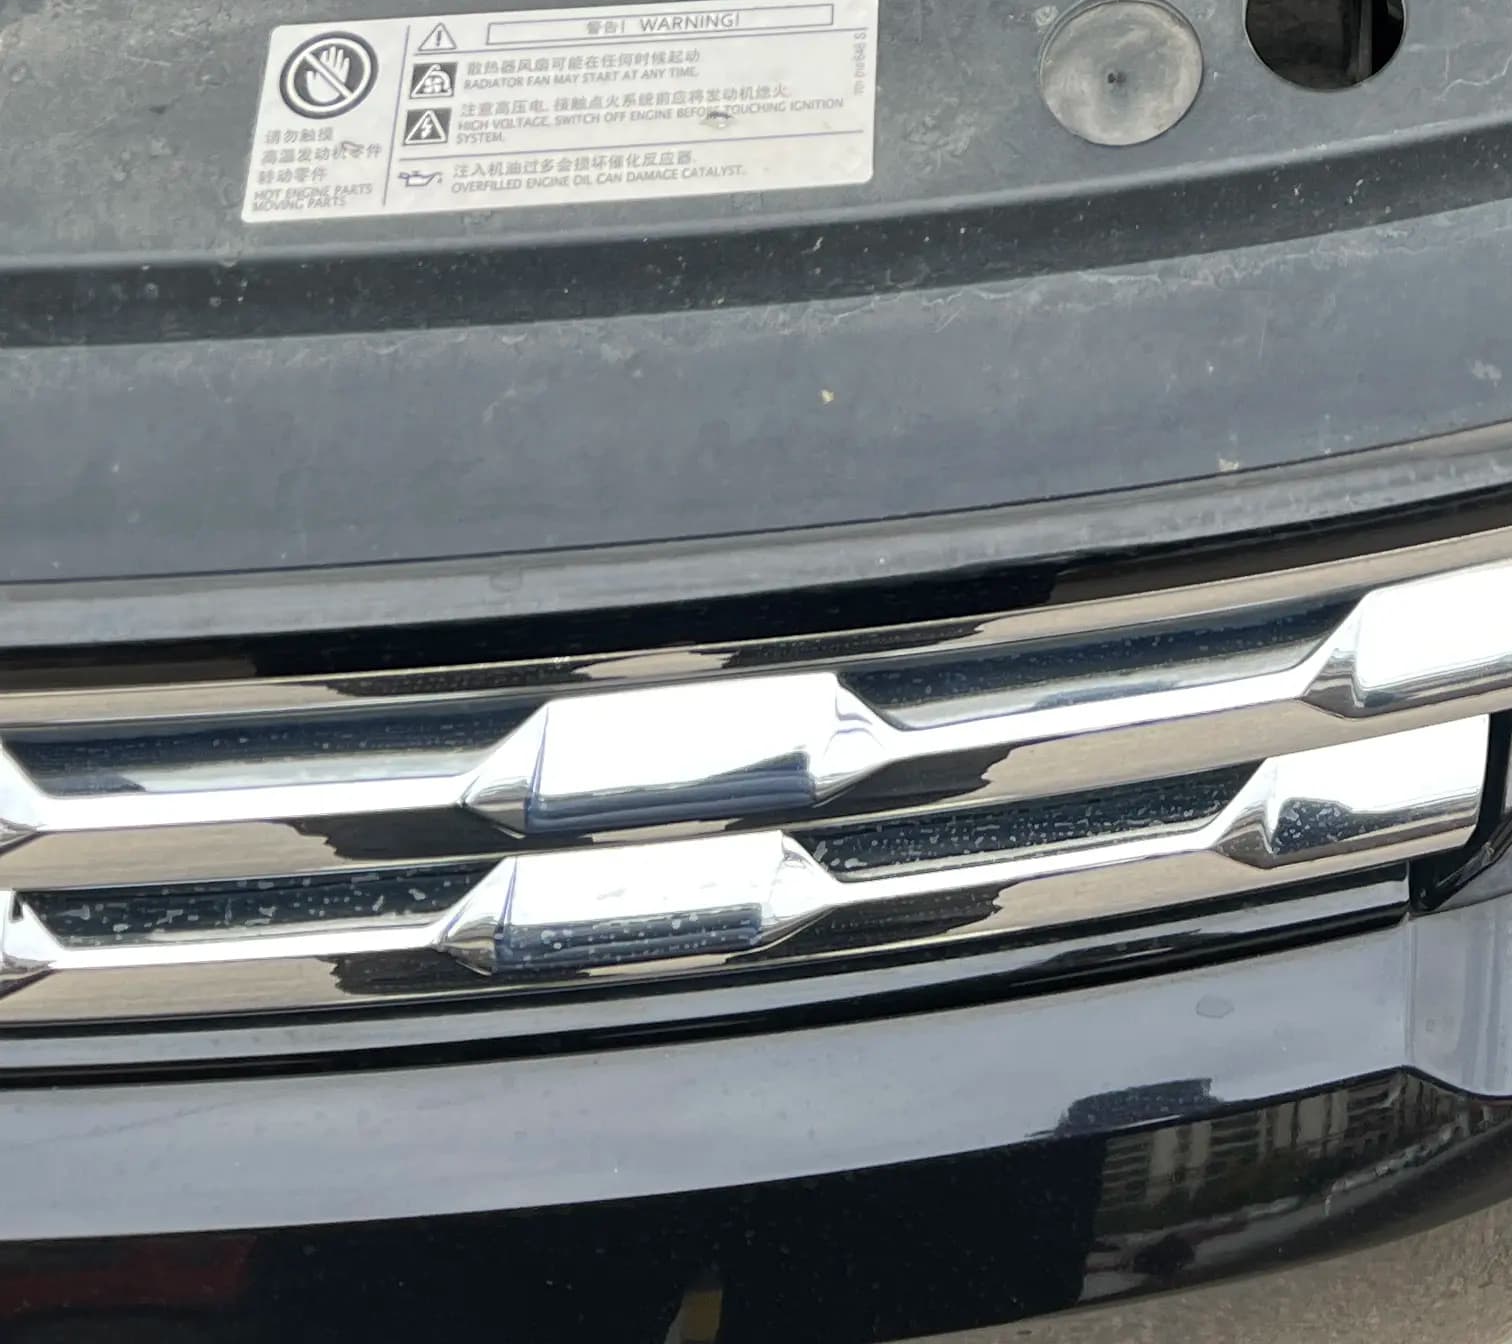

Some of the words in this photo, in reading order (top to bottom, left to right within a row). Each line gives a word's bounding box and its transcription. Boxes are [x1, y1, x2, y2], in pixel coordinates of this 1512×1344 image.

[640, 12, 740, 32] WARNING!
[463, 76, 524, 90] RADIATOR
[526, 75, 551, 86] FAN
[553, 74, 578, 84] MAY
[582, 71, 619, 83] START
[622, 70, 637, 81] AT
[641, 68, 665, 80] ANY
[458, 118, 490, 131] HIGH
[554, 112, 600, 126] SWITCH
[604, 111, 626, 122] OFF
[630, 108, 672, 121] ENGINE
[725, 100, 787, 114] TOUCHING
[790, 97, 844, 110] IGNITION
[286, 185, 331, 199] ENGINE
[334, 183, 373, 194] PARTS
[451, 177, 522, 193] OVERFILLED
[526, 176, 569, 189] ENGINE
[573, 175, 592, 186] OIL
[596, 173, 622, 185] CAN
[626, 170, 679, 183] DAMAGE
[253, 199, 304, 212] MOVING
[307, 195, 346, 208] PARTS
